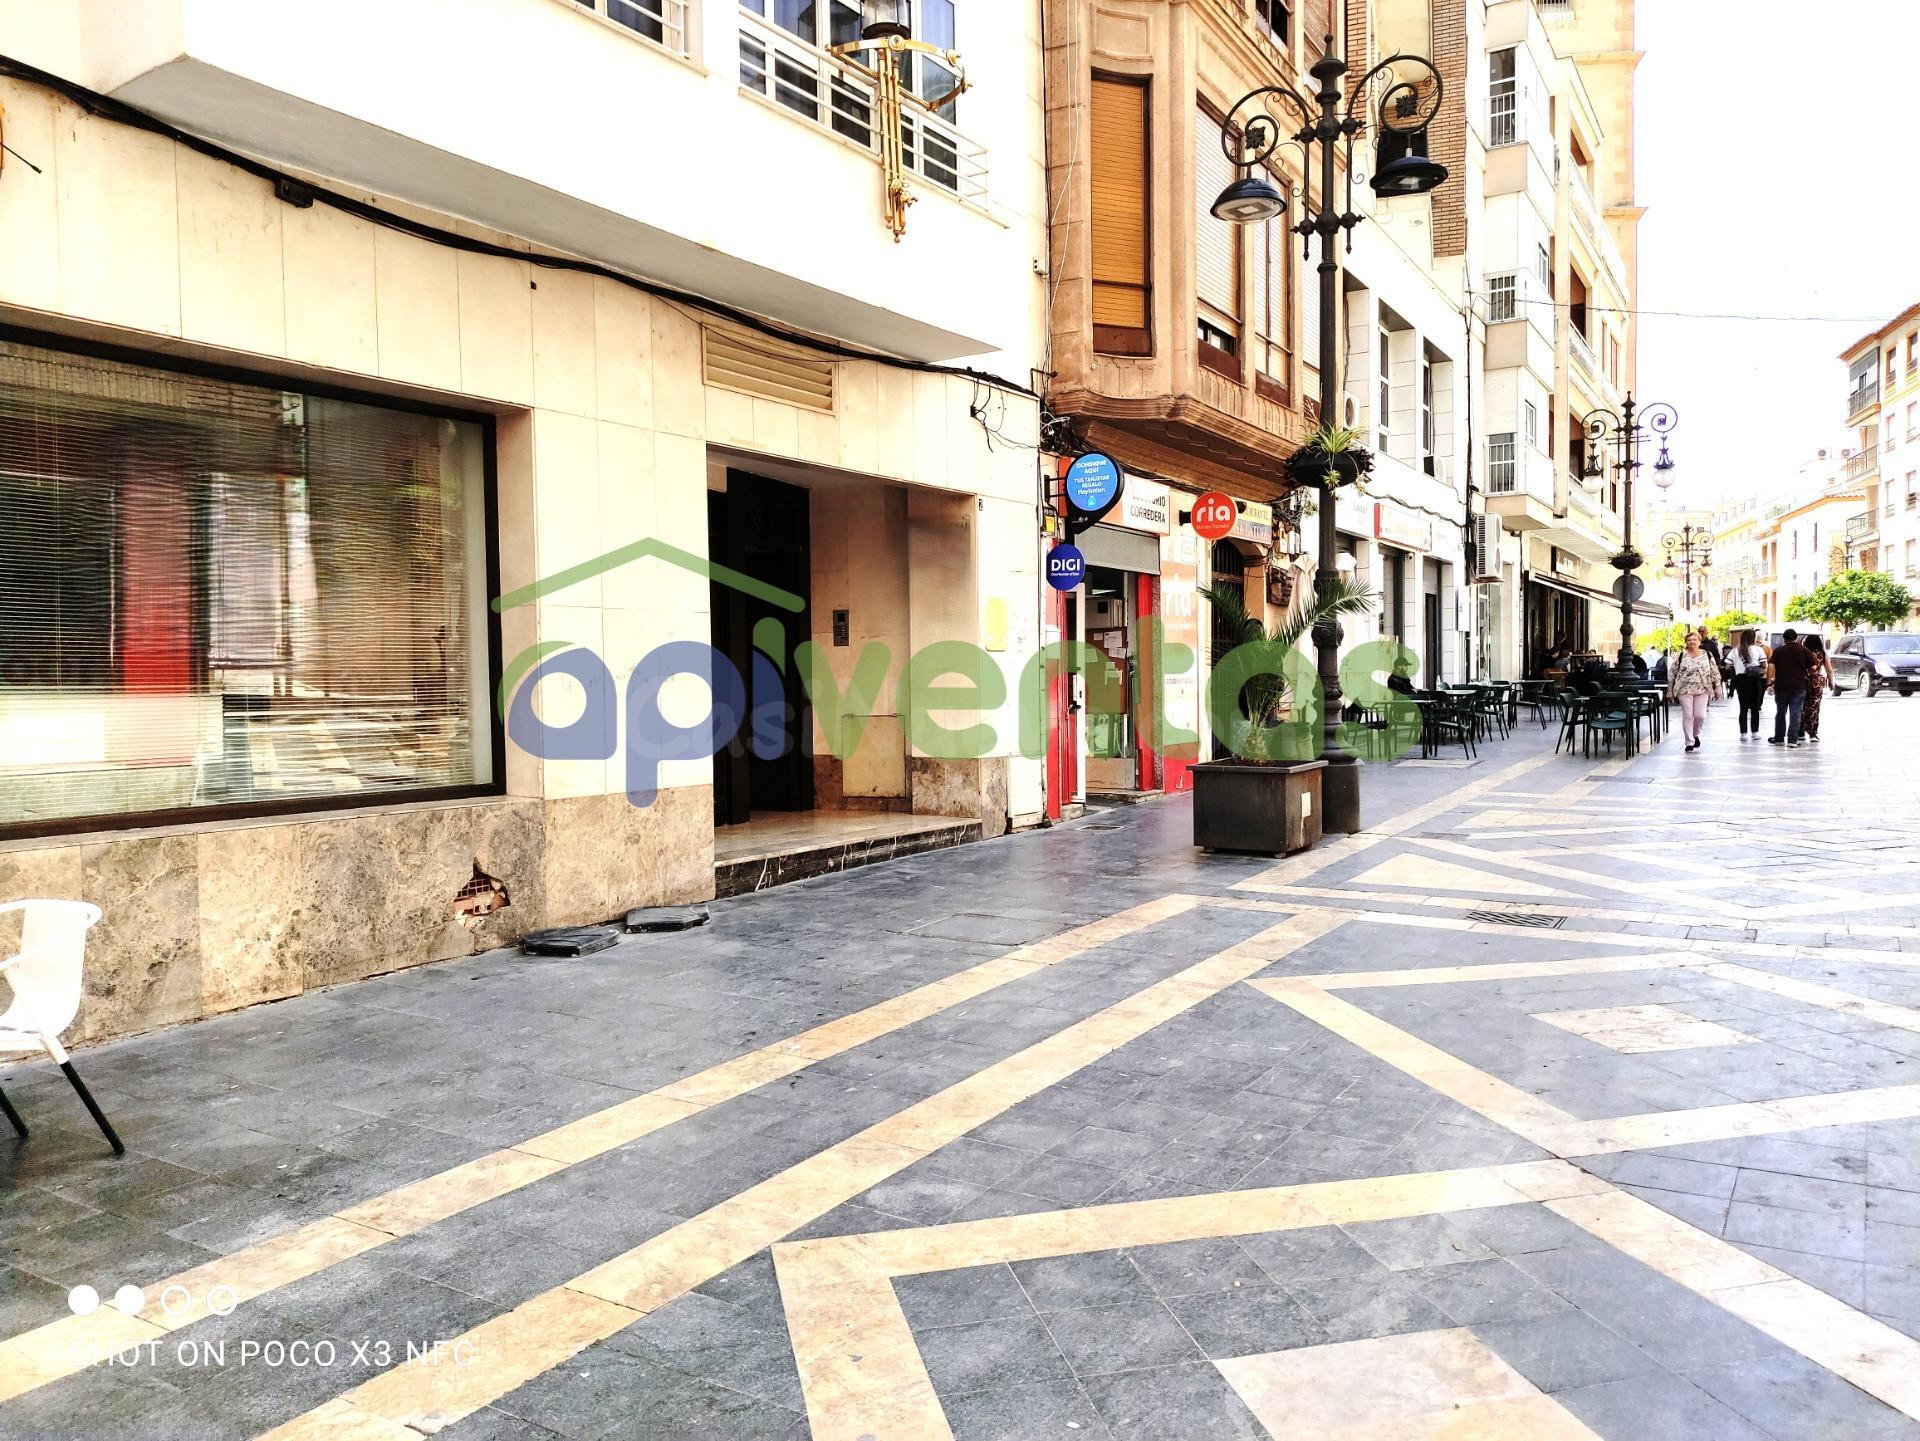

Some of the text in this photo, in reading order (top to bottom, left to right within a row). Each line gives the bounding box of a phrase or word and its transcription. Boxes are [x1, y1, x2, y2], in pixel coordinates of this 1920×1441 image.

[1130, 505, 1166, 524] CORREDERA
[1196, 498, 1231, 523] ria
[1051, 558, 1080, 571] DIGI
